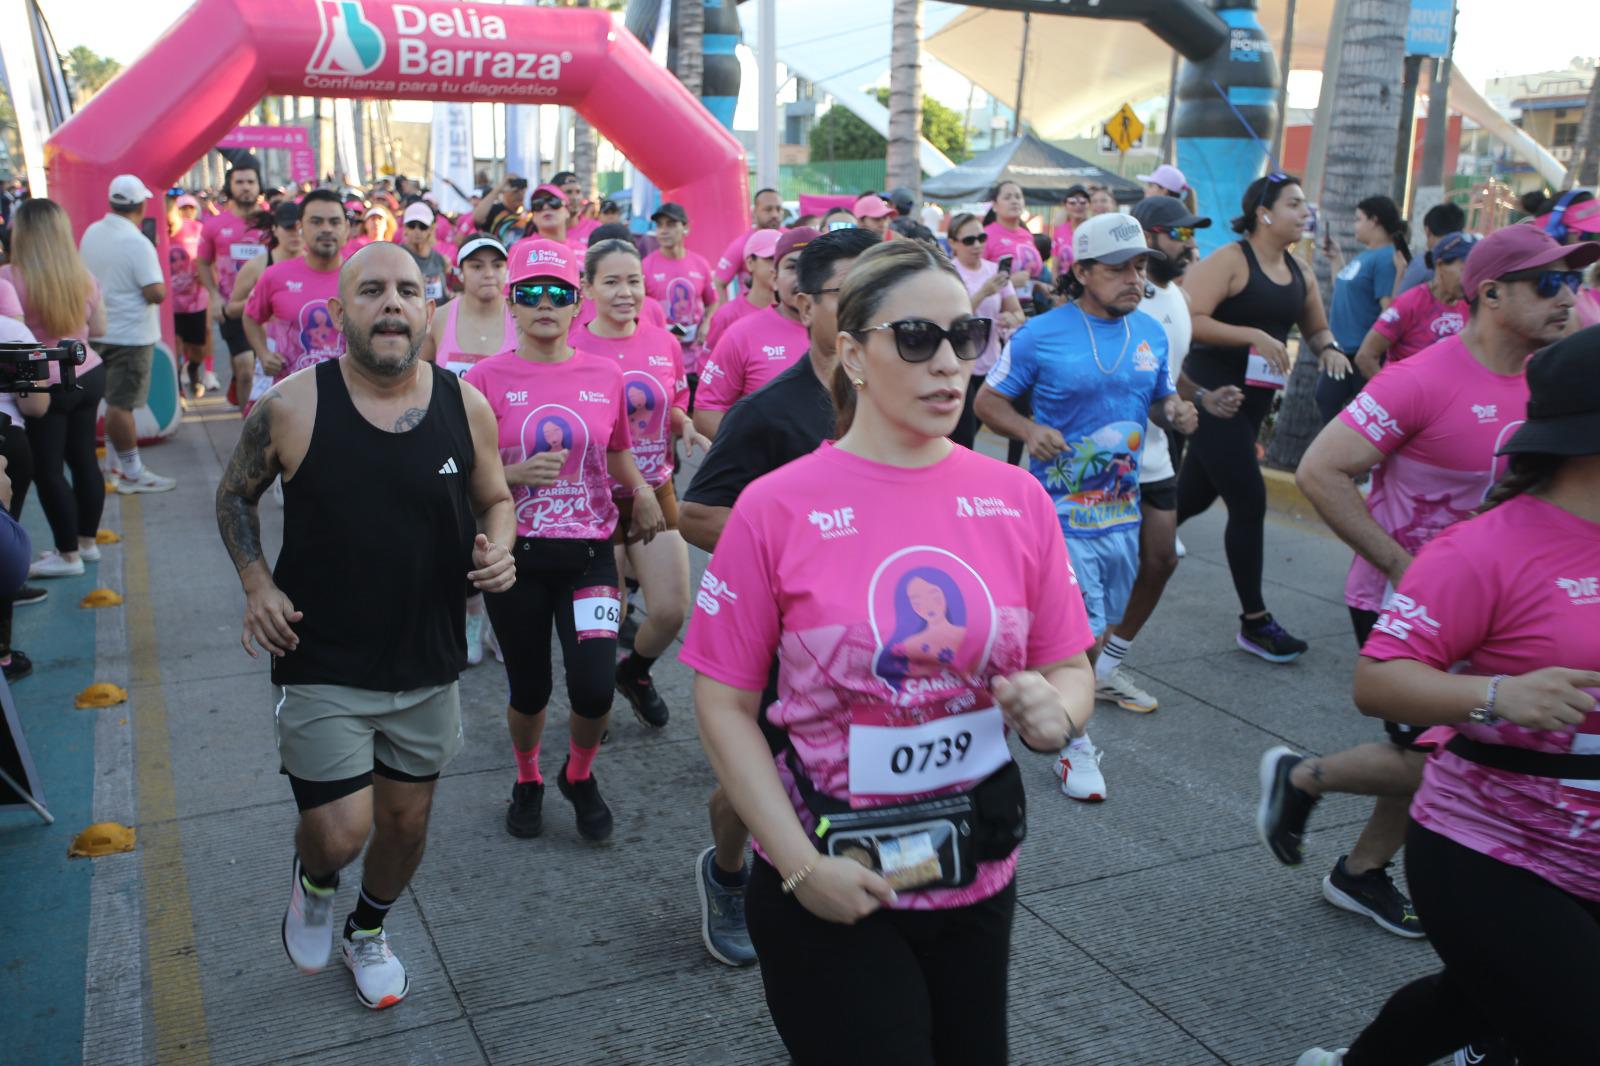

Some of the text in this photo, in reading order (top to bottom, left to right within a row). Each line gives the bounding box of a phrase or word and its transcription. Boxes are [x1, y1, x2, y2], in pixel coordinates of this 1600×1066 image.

[391, 4, 507, 40] Delia
[1409, 9, 1450, 26] RIVE
[303, 74, 558, 97] Confianza para tu diagnóstico
[510, 391, 528, 402] DIF
[538, 486, 584, 497] CARRERA
[516, 496, 586, 530] Rosa
[820, 506, 855, 532] DIF
[890, 730, 972, 774] 0739
